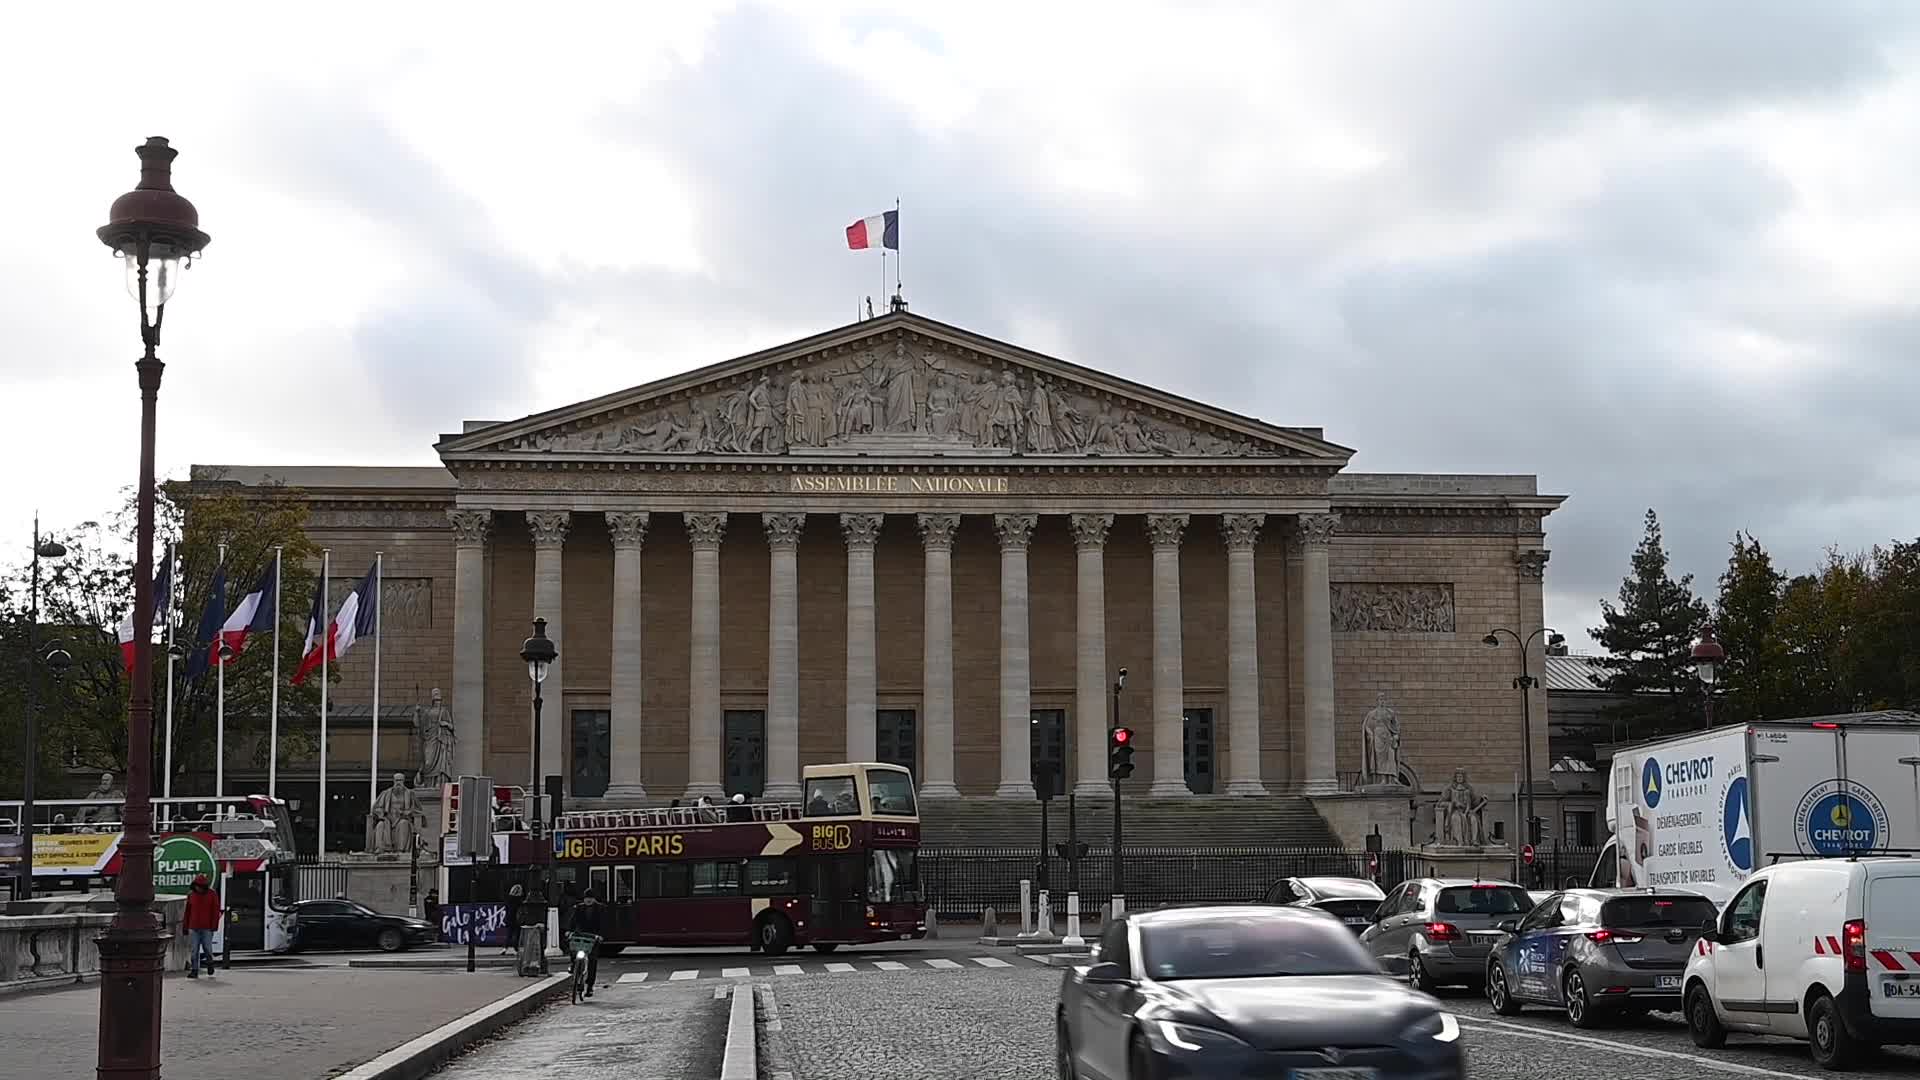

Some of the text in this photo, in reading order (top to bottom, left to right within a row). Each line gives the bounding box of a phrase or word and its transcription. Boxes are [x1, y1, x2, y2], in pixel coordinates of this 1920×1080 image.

[910, 476, 1009, 492] NATIONALE
[1665, 756, 1714, 785] CHEVROT
[1667, 784, 1707, 800] TRANSPORT
[812, 825, 834, 838] BIG
[1814, 829, 1871, 841] CHEVROT
[624, 834, 684, 856] PARIS
[812, 838, 834, 850] BUS
[158, 859, 203, 873] PLANET
